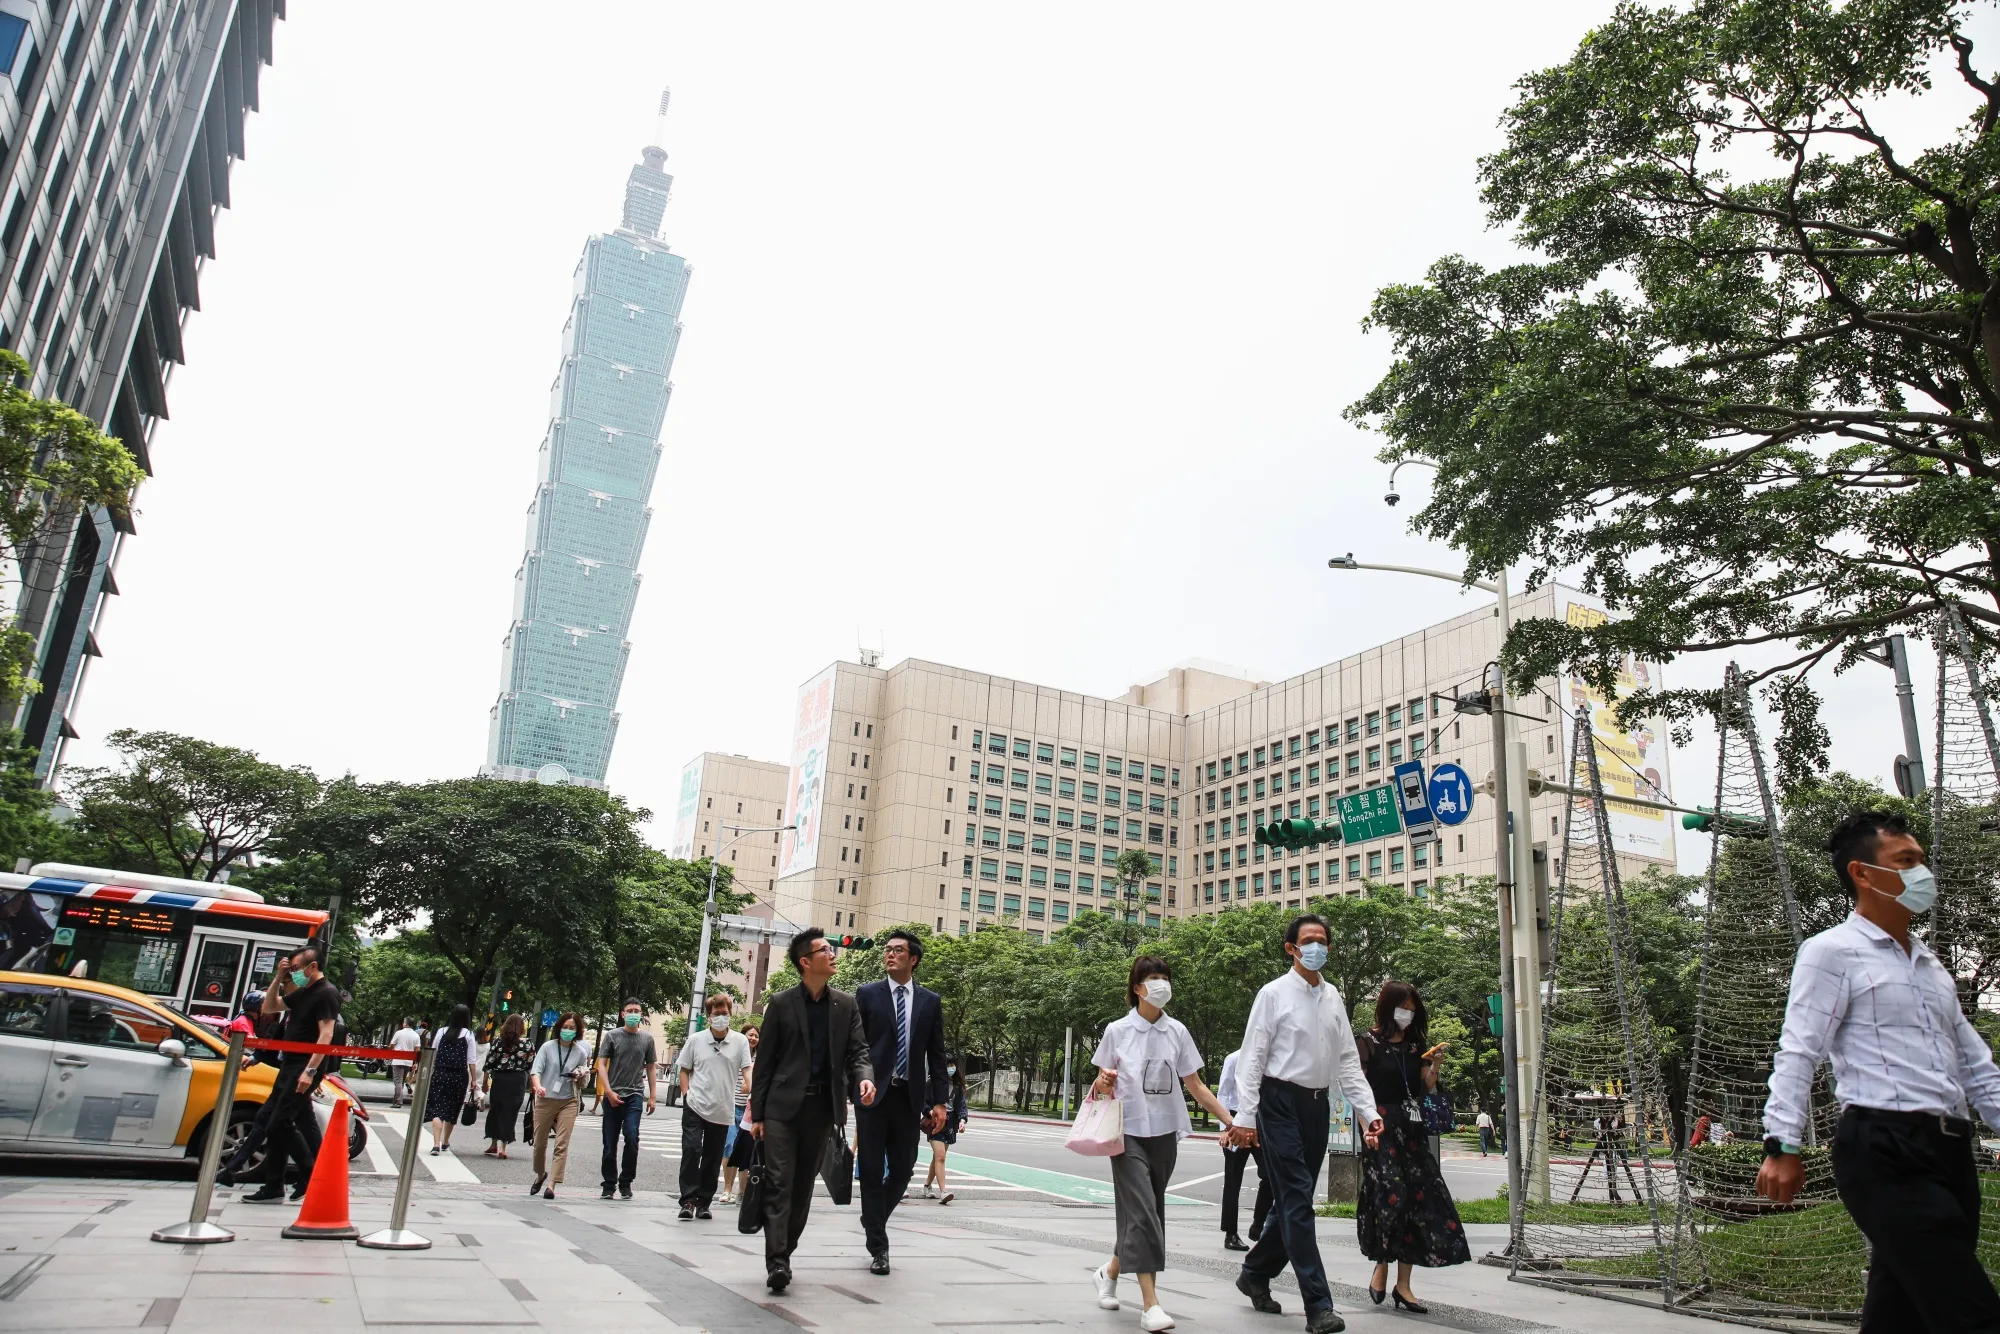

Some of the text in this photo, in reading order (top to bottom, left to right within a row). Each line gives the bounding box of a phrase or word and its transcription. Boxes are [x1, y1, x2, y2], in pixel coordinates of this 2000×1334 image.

[1342, 789, 1388, 813] 松智路
[1347, 807, 1388, 823] SongZhi Rd.
[507, 990, 513, 1000] 6
